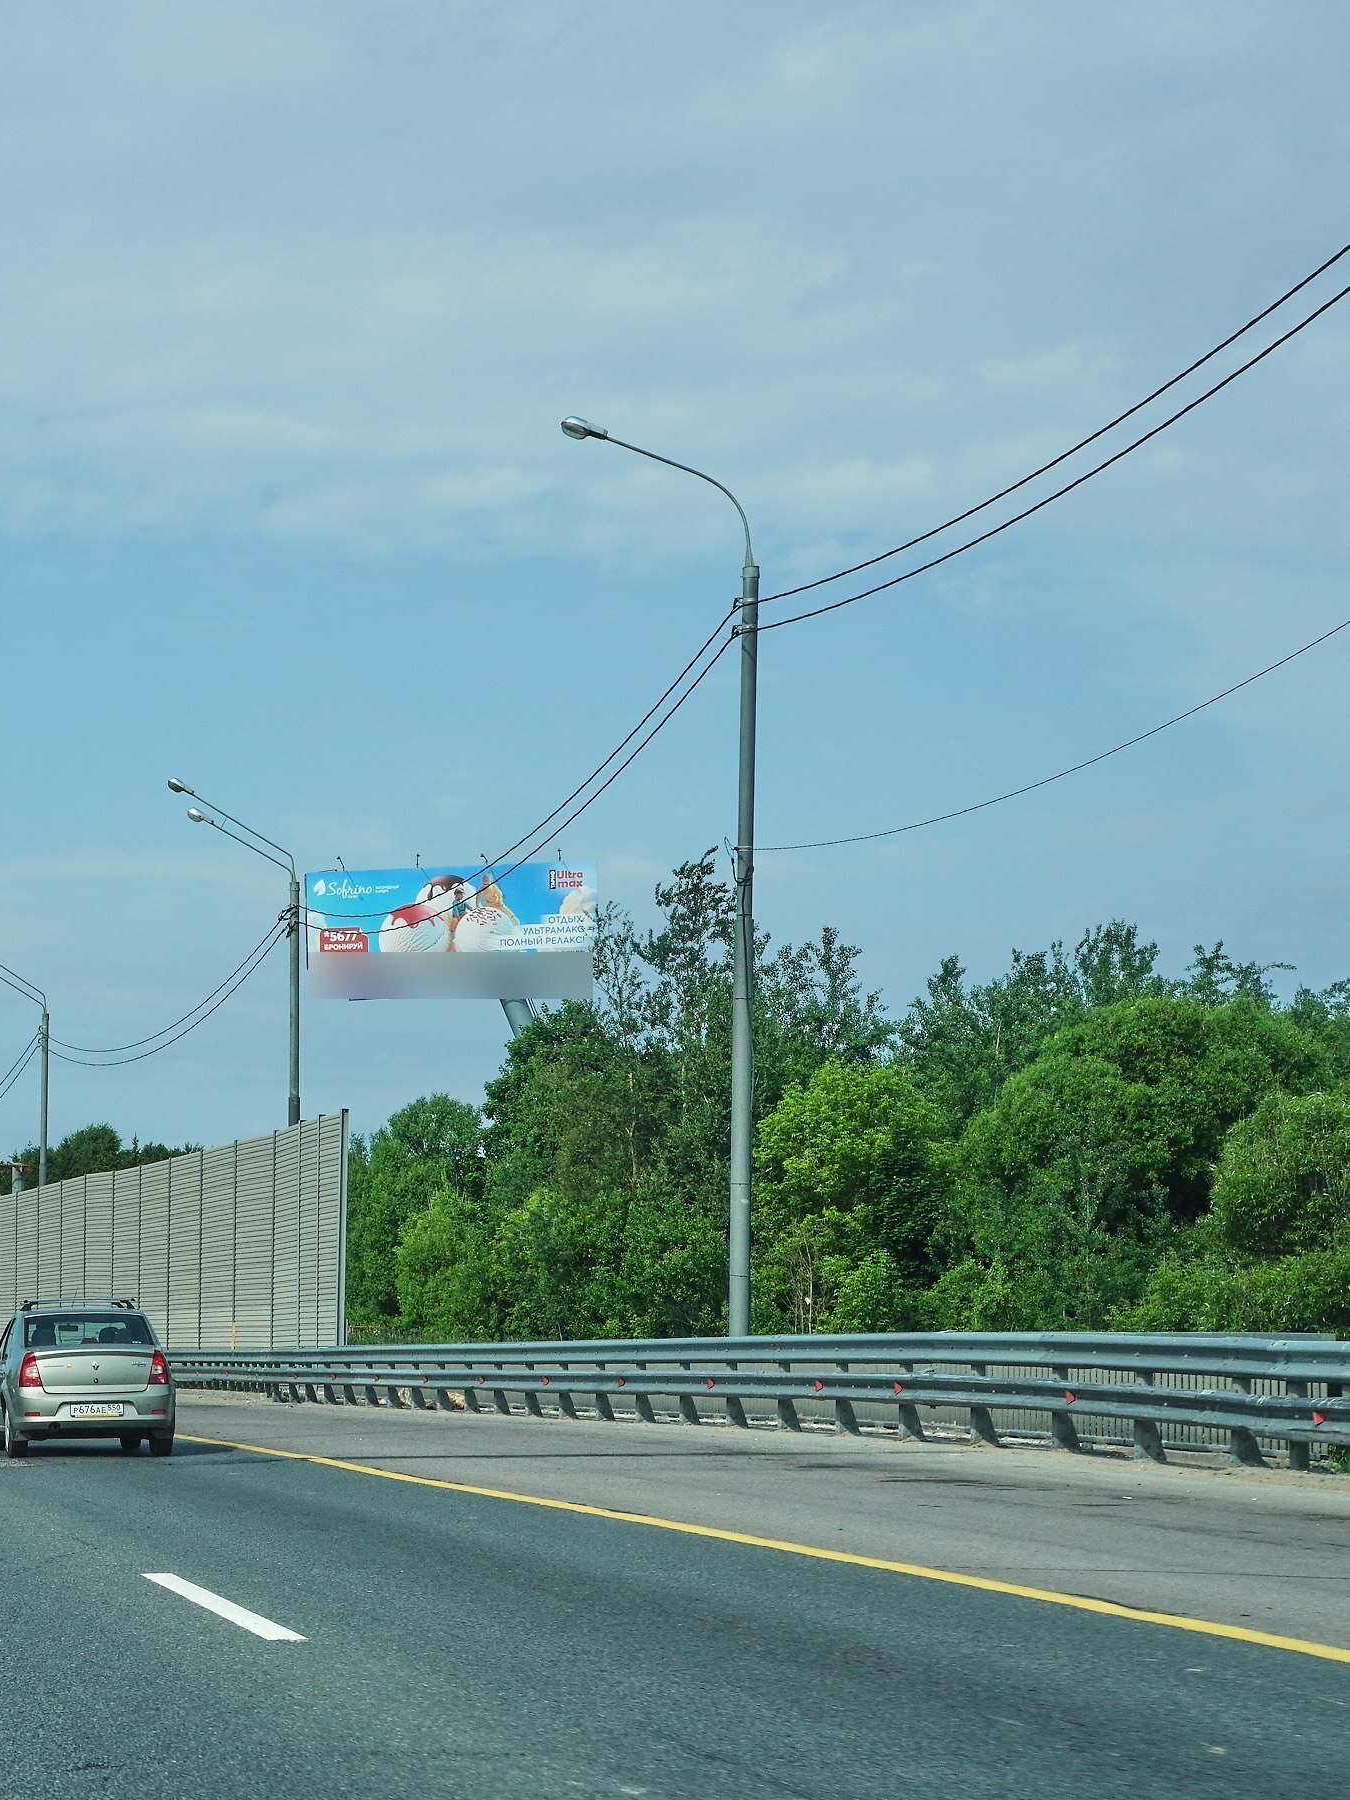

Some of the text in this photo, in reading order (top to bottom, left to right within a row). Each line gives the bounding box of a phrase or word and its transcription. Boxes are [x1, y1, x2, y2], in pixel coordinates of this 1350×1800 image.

[556, 870, 583, 879] Ultra
[557, 880, 583, 888] max
[326, 879, 373, 899] Sofrino
[523, 925, 584, 935] УЛЬТРАМАКС
[500, 935, 585, 947] ПОЛНЫЙ РЕЛАКС!
[324, 942, 363, 951] БРОНИРУЙ
